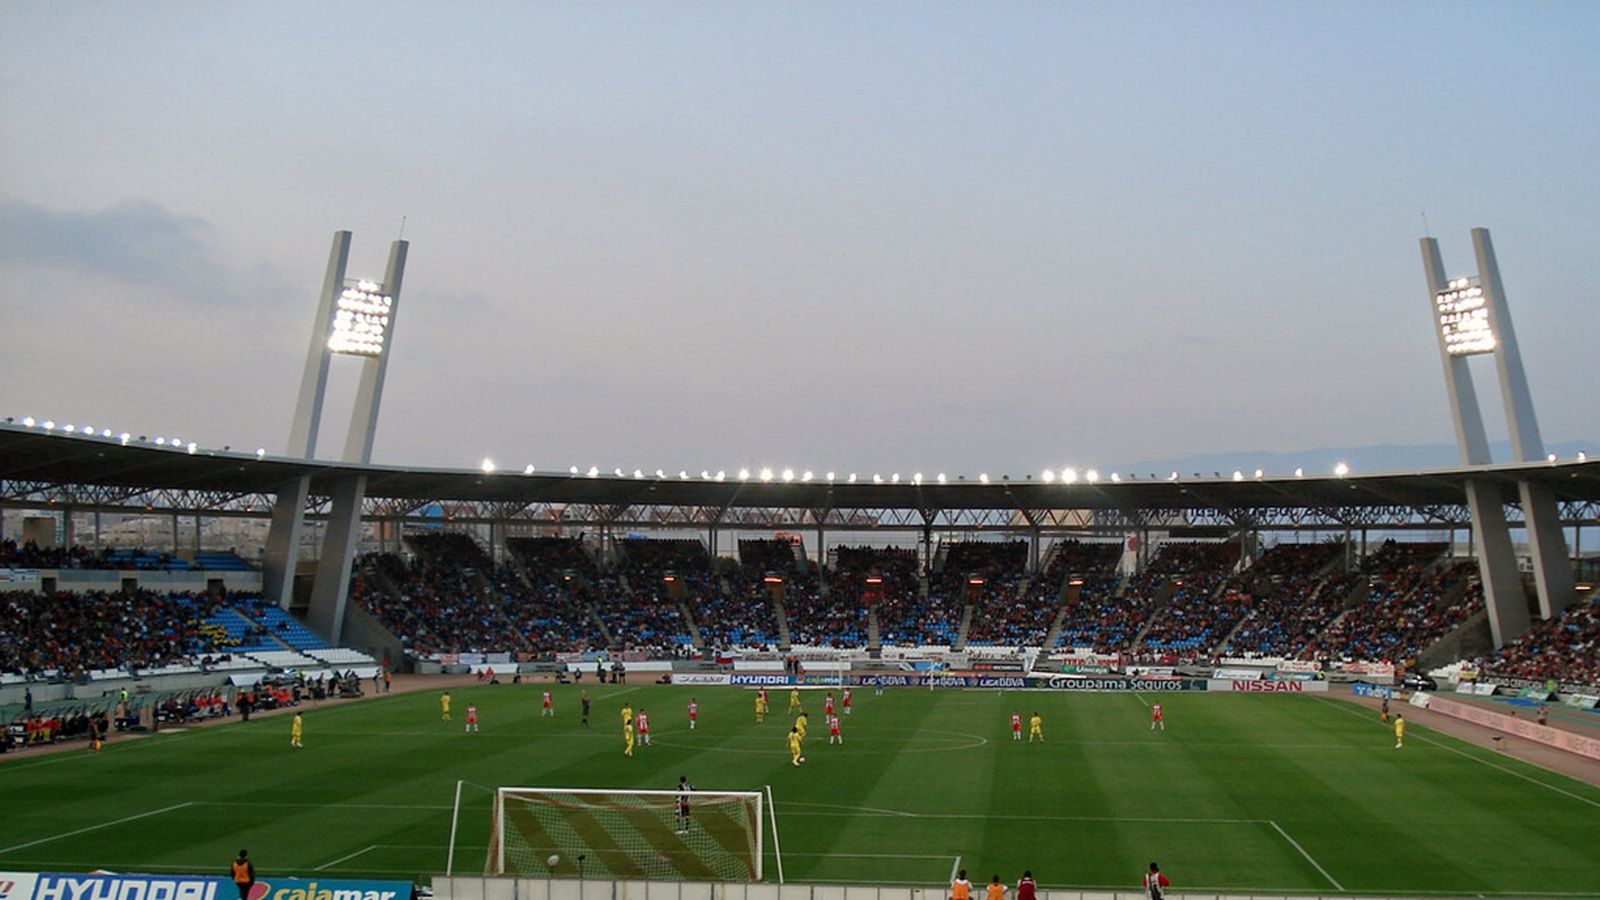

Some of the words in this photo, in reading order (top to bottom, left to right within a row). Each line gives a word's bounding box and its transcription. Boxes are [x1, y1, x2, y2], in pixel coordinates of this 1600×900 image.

[731, 675, 789, 685] HYUNDAI
[980, 678, 1000, 687] LIGA
[1000, 677, 1025, 687] BBVA
[1049, 676, 1127, 690] Groupama
[1131, 677, 1182, 690] Seguros
[1232, 681, 1302, 692] NISSAN
[36, 879, 218, 900] HYUNDAI
[273, 882, 397, 900] cajamar
